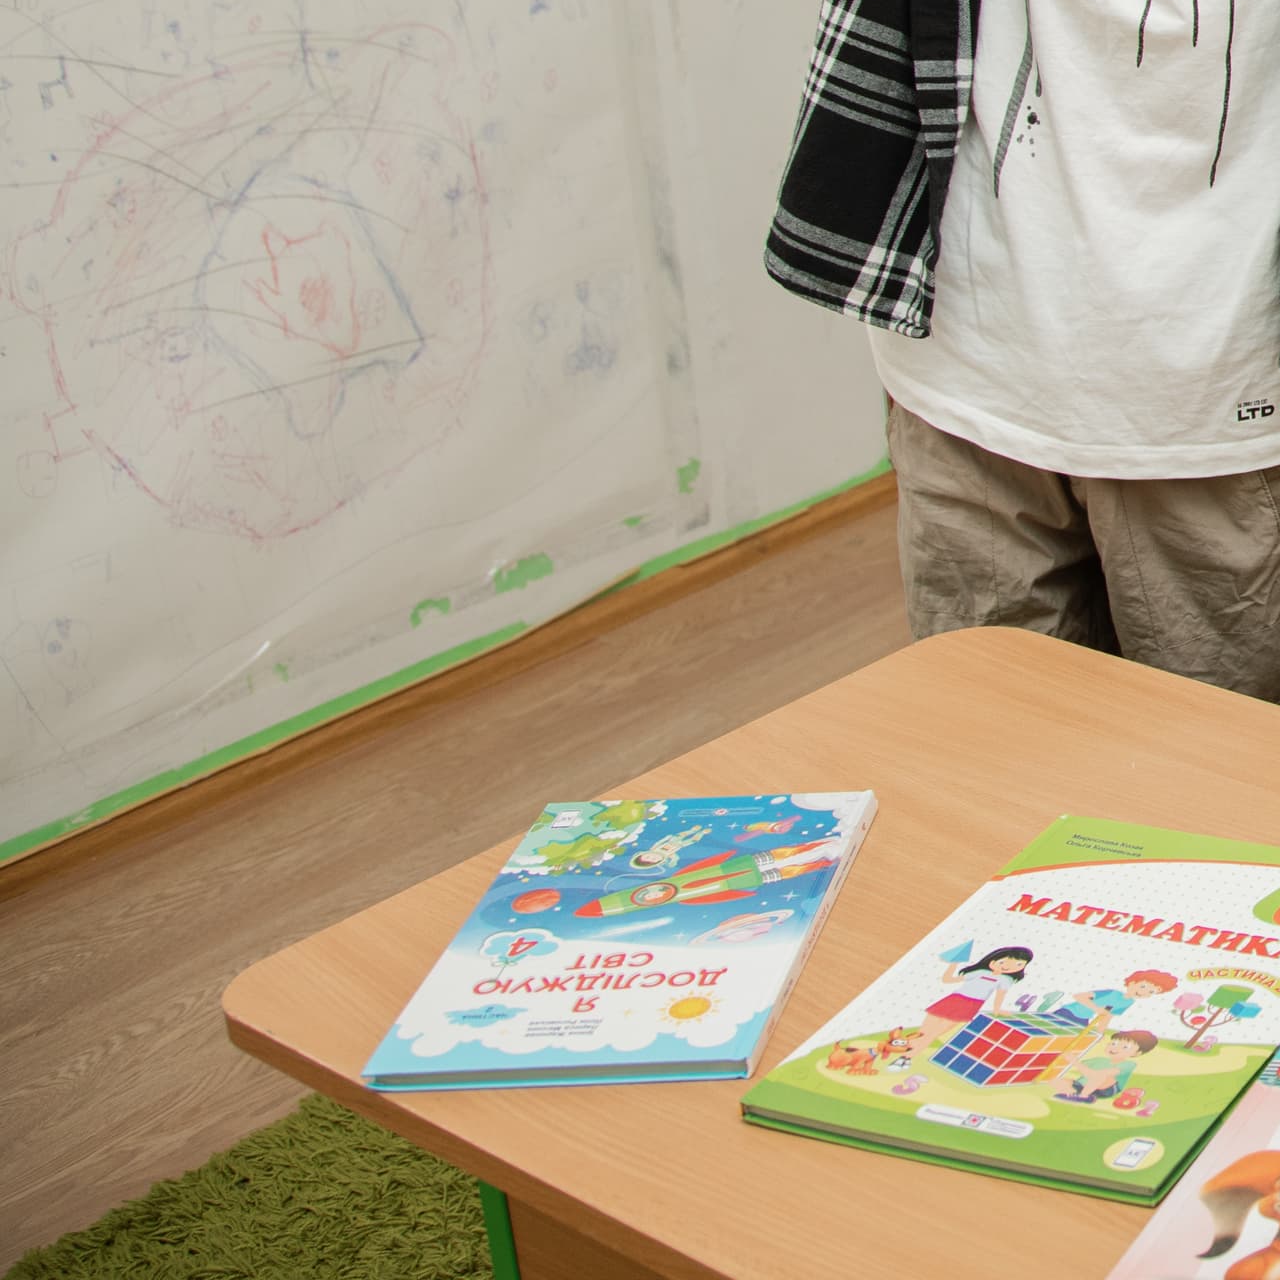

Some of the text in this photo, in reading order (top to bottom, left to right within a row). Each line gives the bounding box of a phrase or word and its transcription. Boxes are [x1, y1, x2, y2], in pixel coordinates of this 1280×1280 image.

[1237, 405, 1275, 422] LTD
[507, 937, 539, 957] 4
[565, 951, 655, 971] СВІТ
[472, 967, 728, 996] ДОСЛІДЖУЮ
[1189, 968, 1271, 987] ЧАСТИНА
[571, 996, 601, 1013] Я
